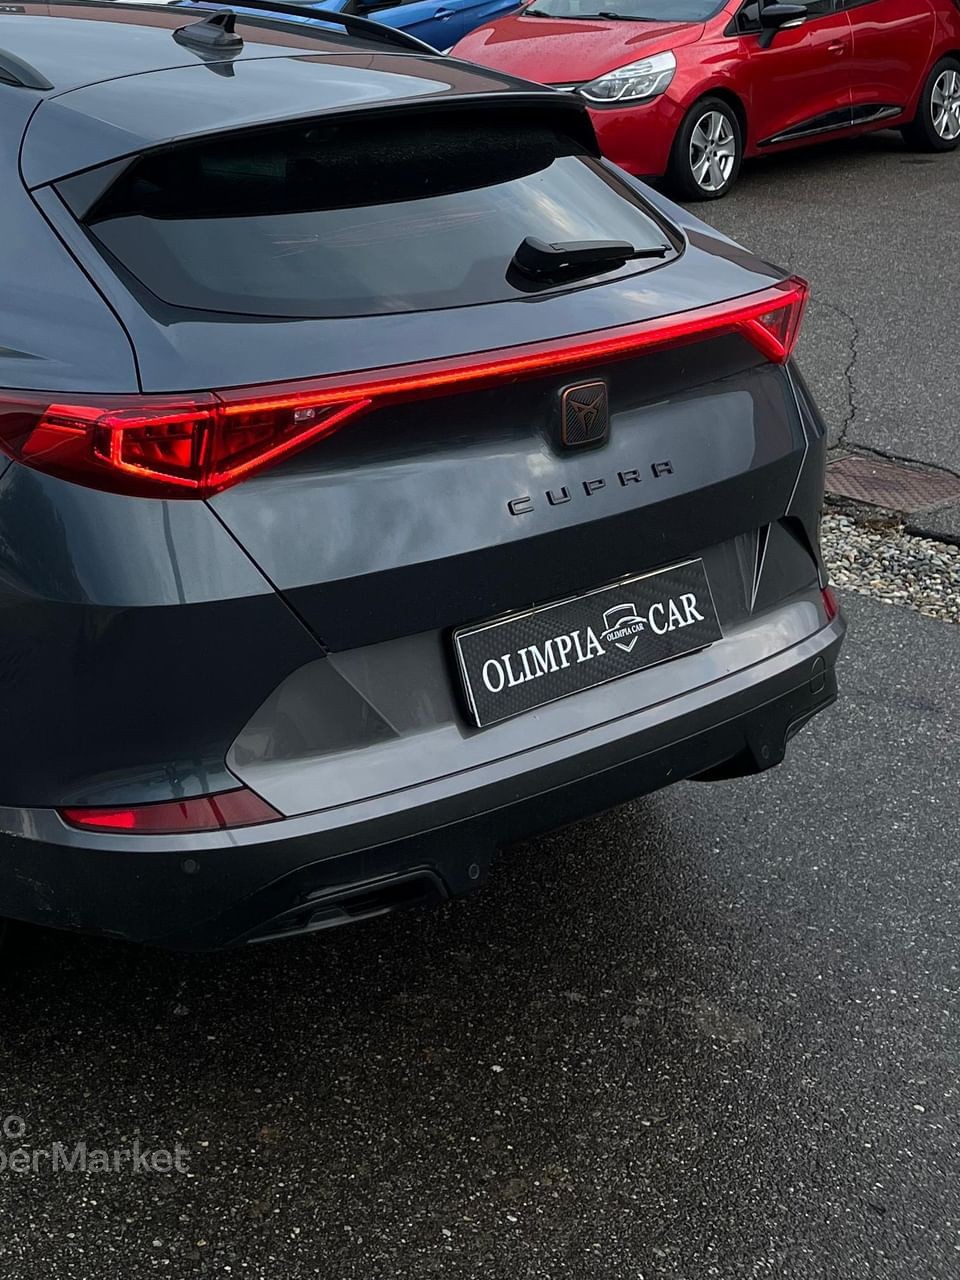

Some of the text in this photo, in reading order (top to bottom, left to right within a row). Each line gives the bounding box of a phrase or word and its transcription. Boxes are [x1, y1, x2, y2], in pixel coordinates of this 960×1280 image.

[507, 460, 674, 516] CUPRA
[482, 593, 705, 694] OLIMPIA CAR
[606, 622, 645, 642] OLIMPIA CAR
